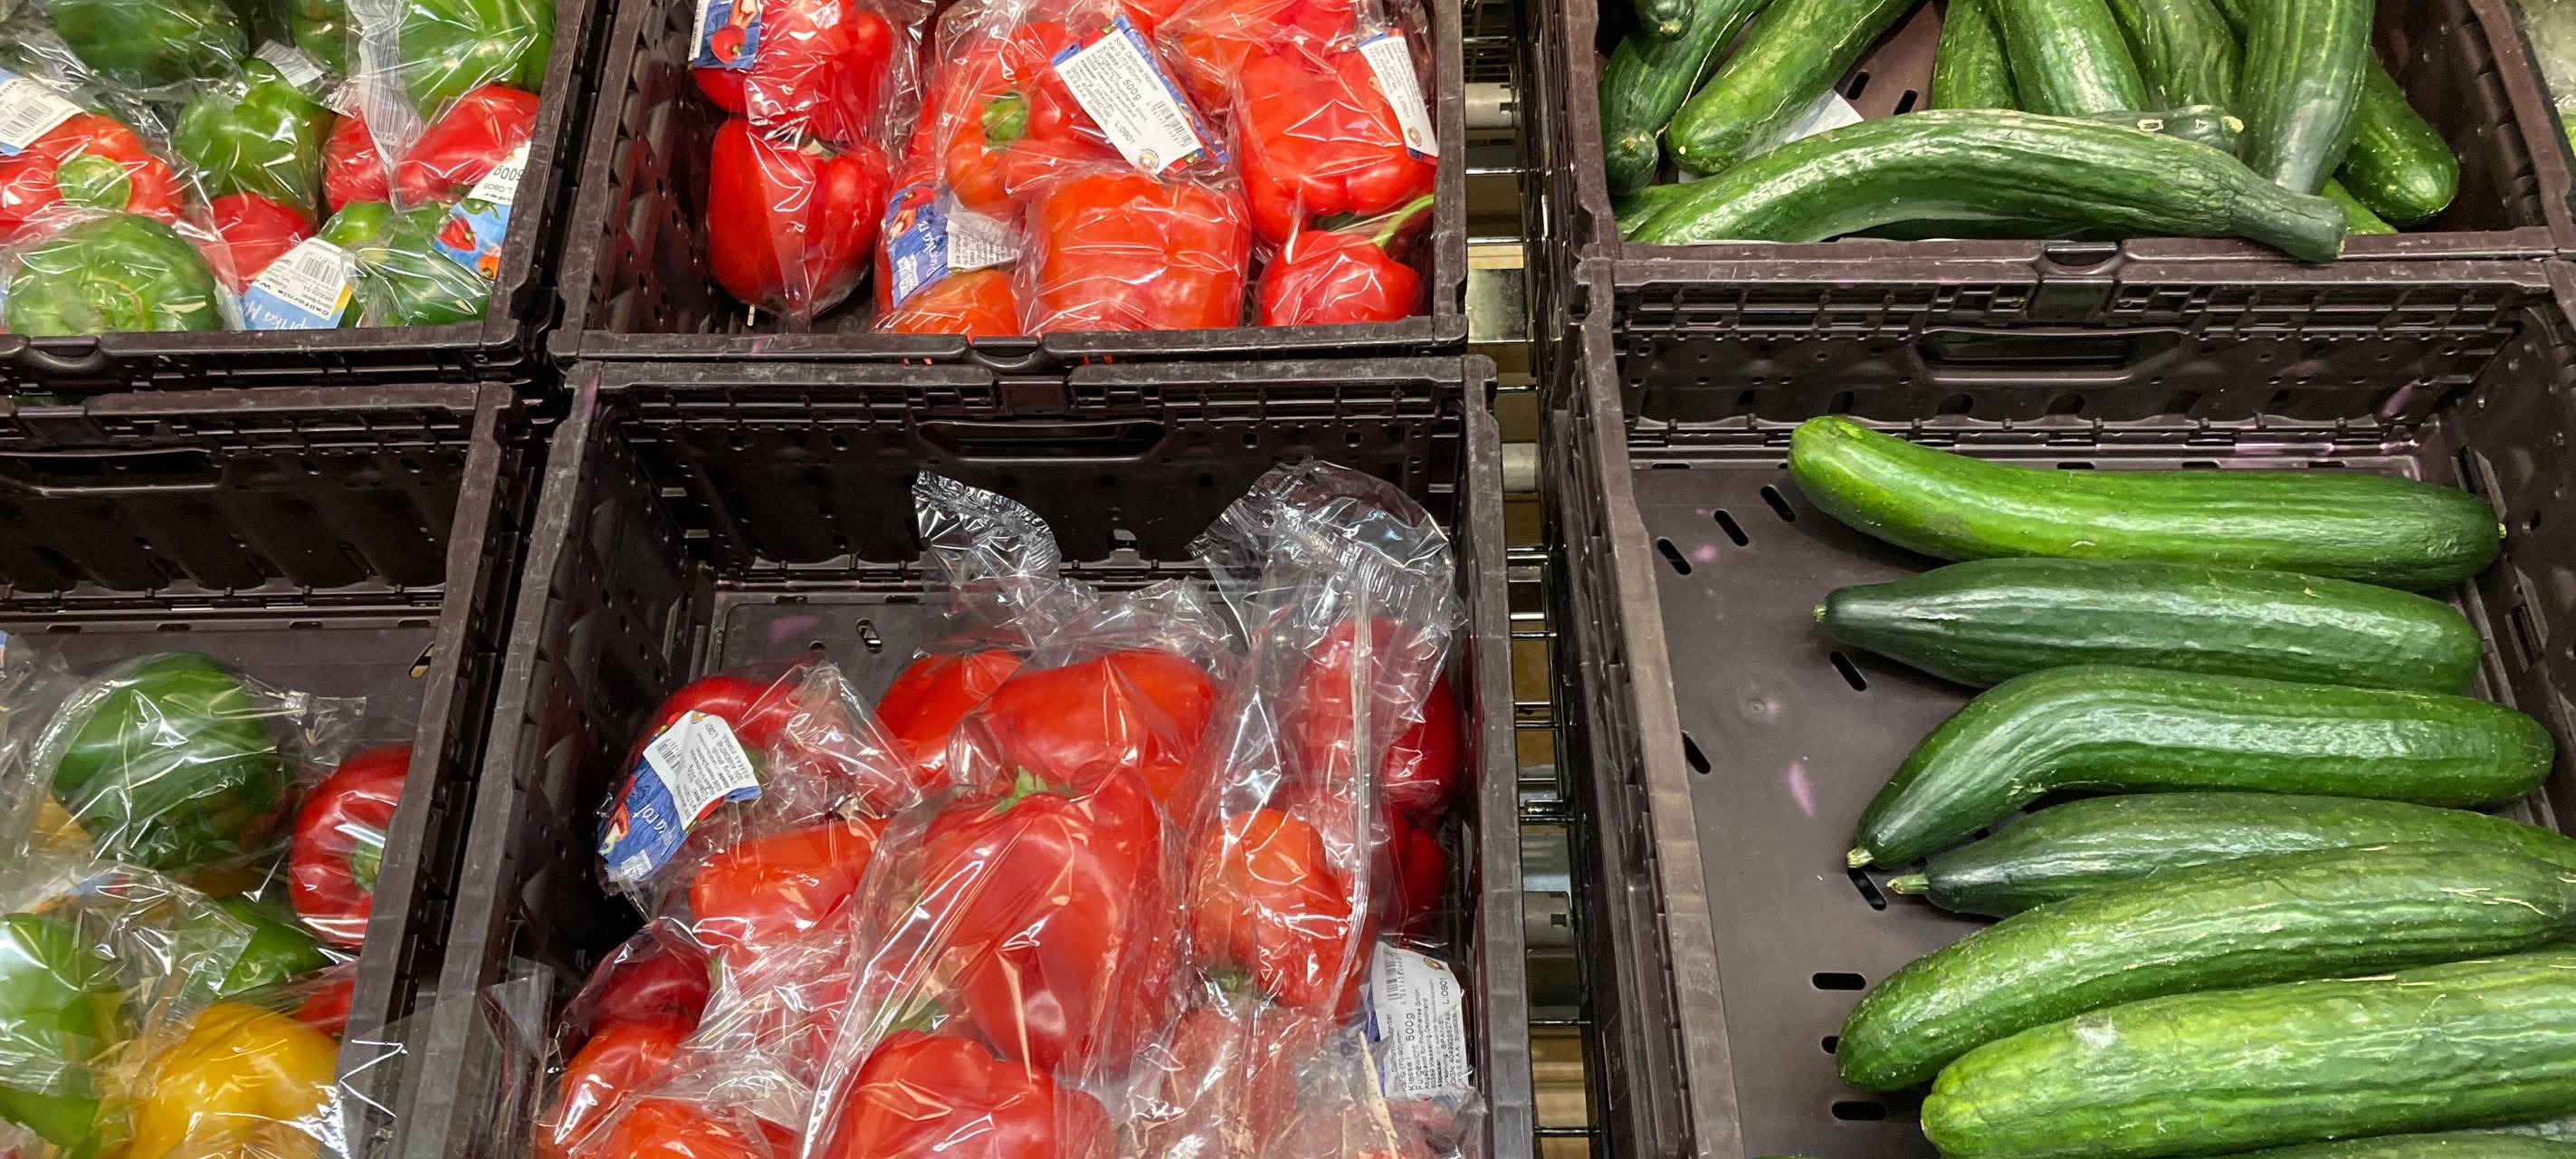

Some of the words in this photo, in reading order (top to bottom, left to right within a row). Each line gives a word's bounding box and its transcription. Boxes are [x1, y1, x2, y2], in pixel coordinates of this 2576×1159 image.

[1123, 50, 1145, 73] California
[1141, 71, 1159, 91] Wonder
[1093, 87, 1116, 113] SPANIEN
[1121, 77, 1143, 102] 500g
[275, 285, 329, 319] California
[260, 311, 307, 330] prika
[632, 802, 660, 824] rot
[1403, 1011, 1417, 1041] 500g
[1421, 997, 1430, 1032] Deutschland
[1425, 1033, 1435, 1067] Wesseling
[1420, 1055, 1431, 1089] Abgepackt
